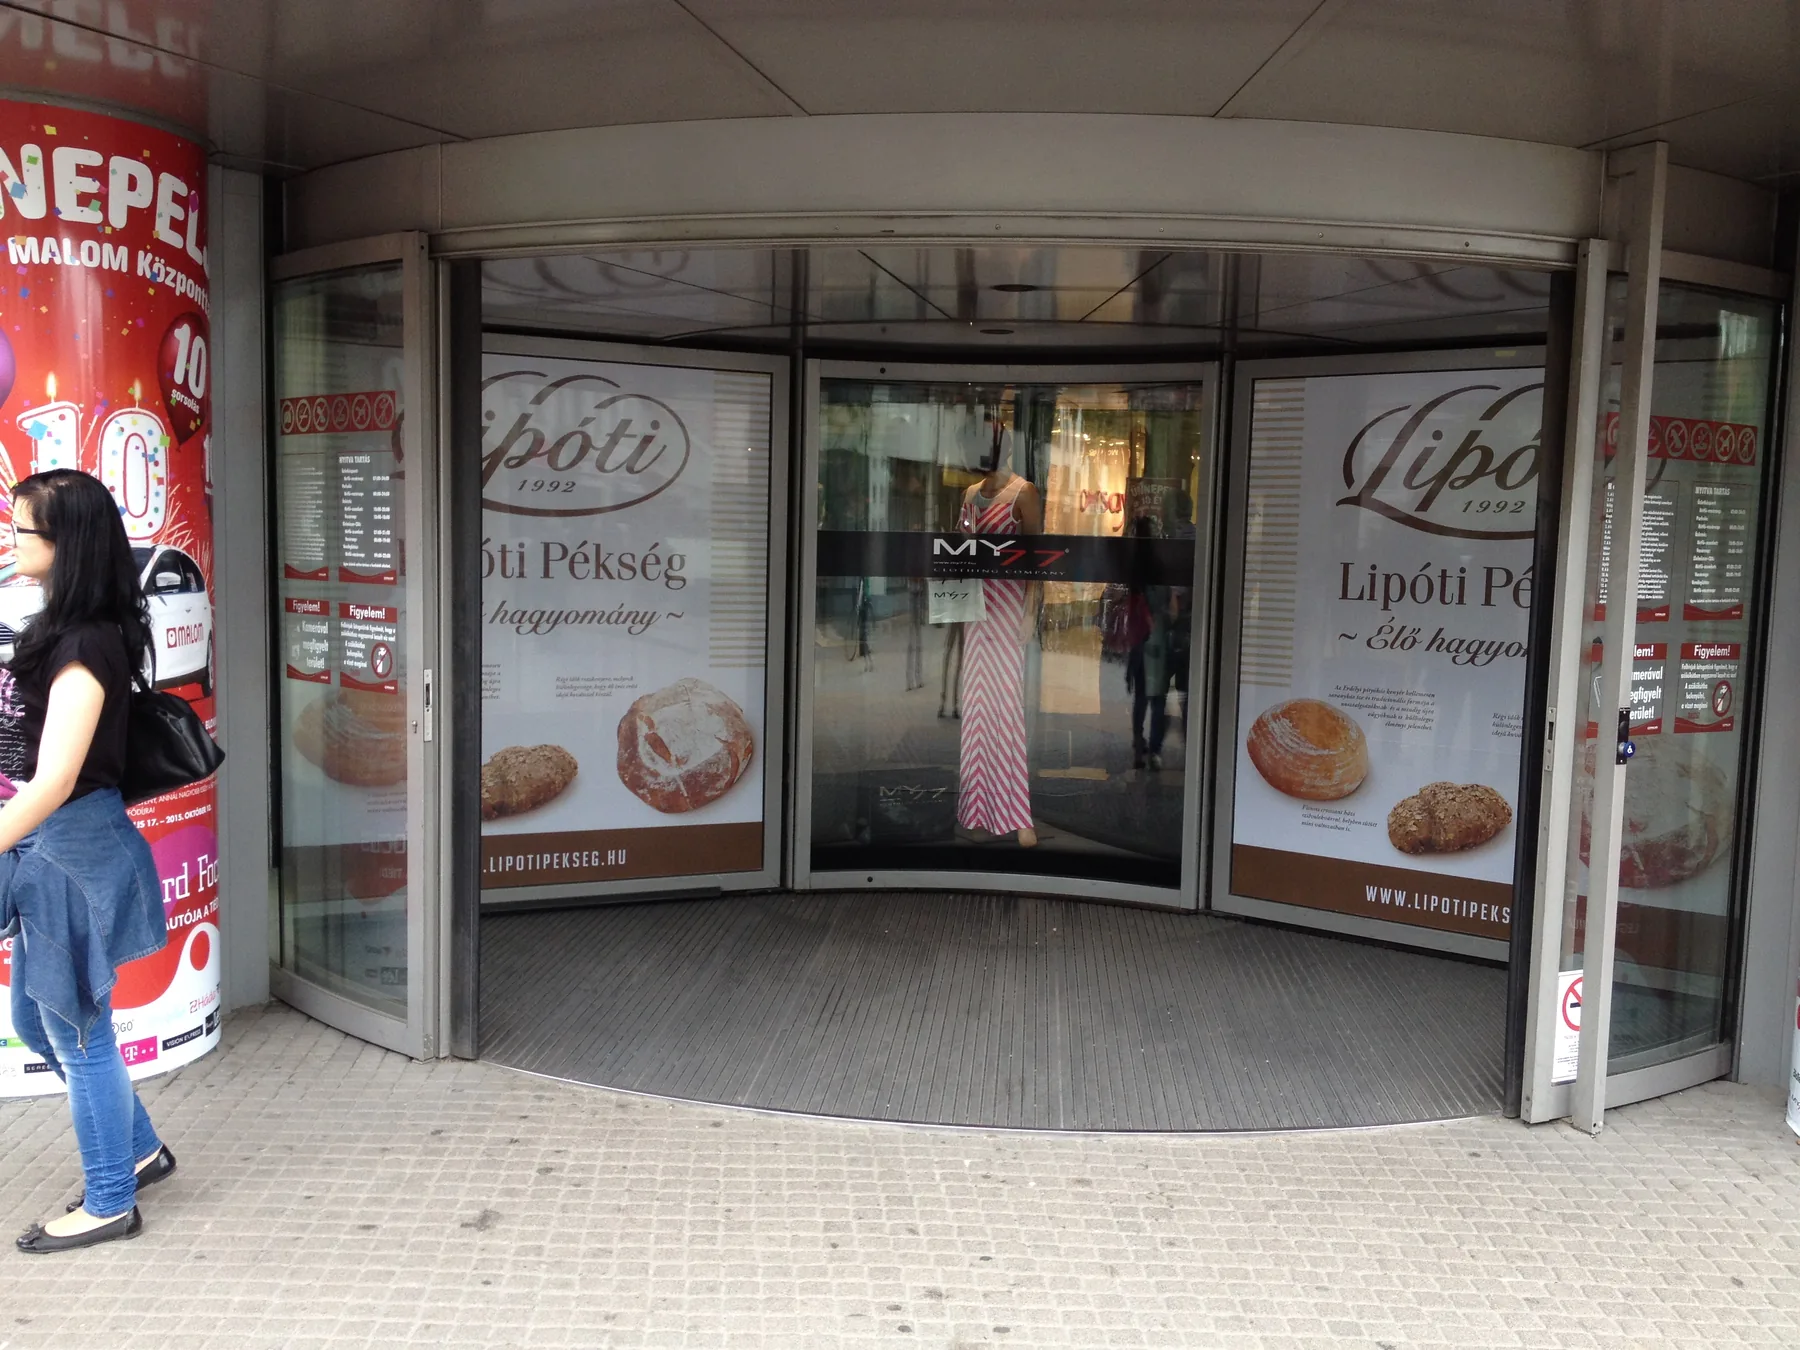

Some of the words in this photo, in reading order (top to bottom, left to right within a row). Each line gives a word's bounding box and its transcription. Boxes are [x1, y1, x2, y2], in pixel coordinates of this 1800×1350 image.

[0, 143, 209, 278] NEPEL
[8, 236, 128, 273] MALOM
[174, 324, 207, 399] 10
[171, 389, 200, 415] sorsolás
[16, 401, 170, 542] 10
[517, 479, 576, 493] 1992
[1462, 500, 1526, 514] 1992
[540, 540, 687, 590] Pékség
[933, 538, 1065, 567] MY77
[934, 590, 969, 600] MY77
[1338, 562, 1467, 611] Lipóti
[292, 600, 321, 614] Figyelem!
[349, 604, 386, 620] Figyelem!
[489, 600, 661, 636] hagyomány
[178, 622, 204, 648] MALOM
[1366, 616, 1423, 652] Élő
[1694, 645, 1731, 659] Figyelem!
[147, 817, 159, 827] 17.
[165, 812, 184, 824] 2015.
[482, 849, 627, 873] .LIPOTIPEKSEG.HU
[162, 862, 190, 903] rd
[1365, 884, 1511, 924] WWW.LIPOTIPEKS
[166, 1037, 184, 1048] VISION
